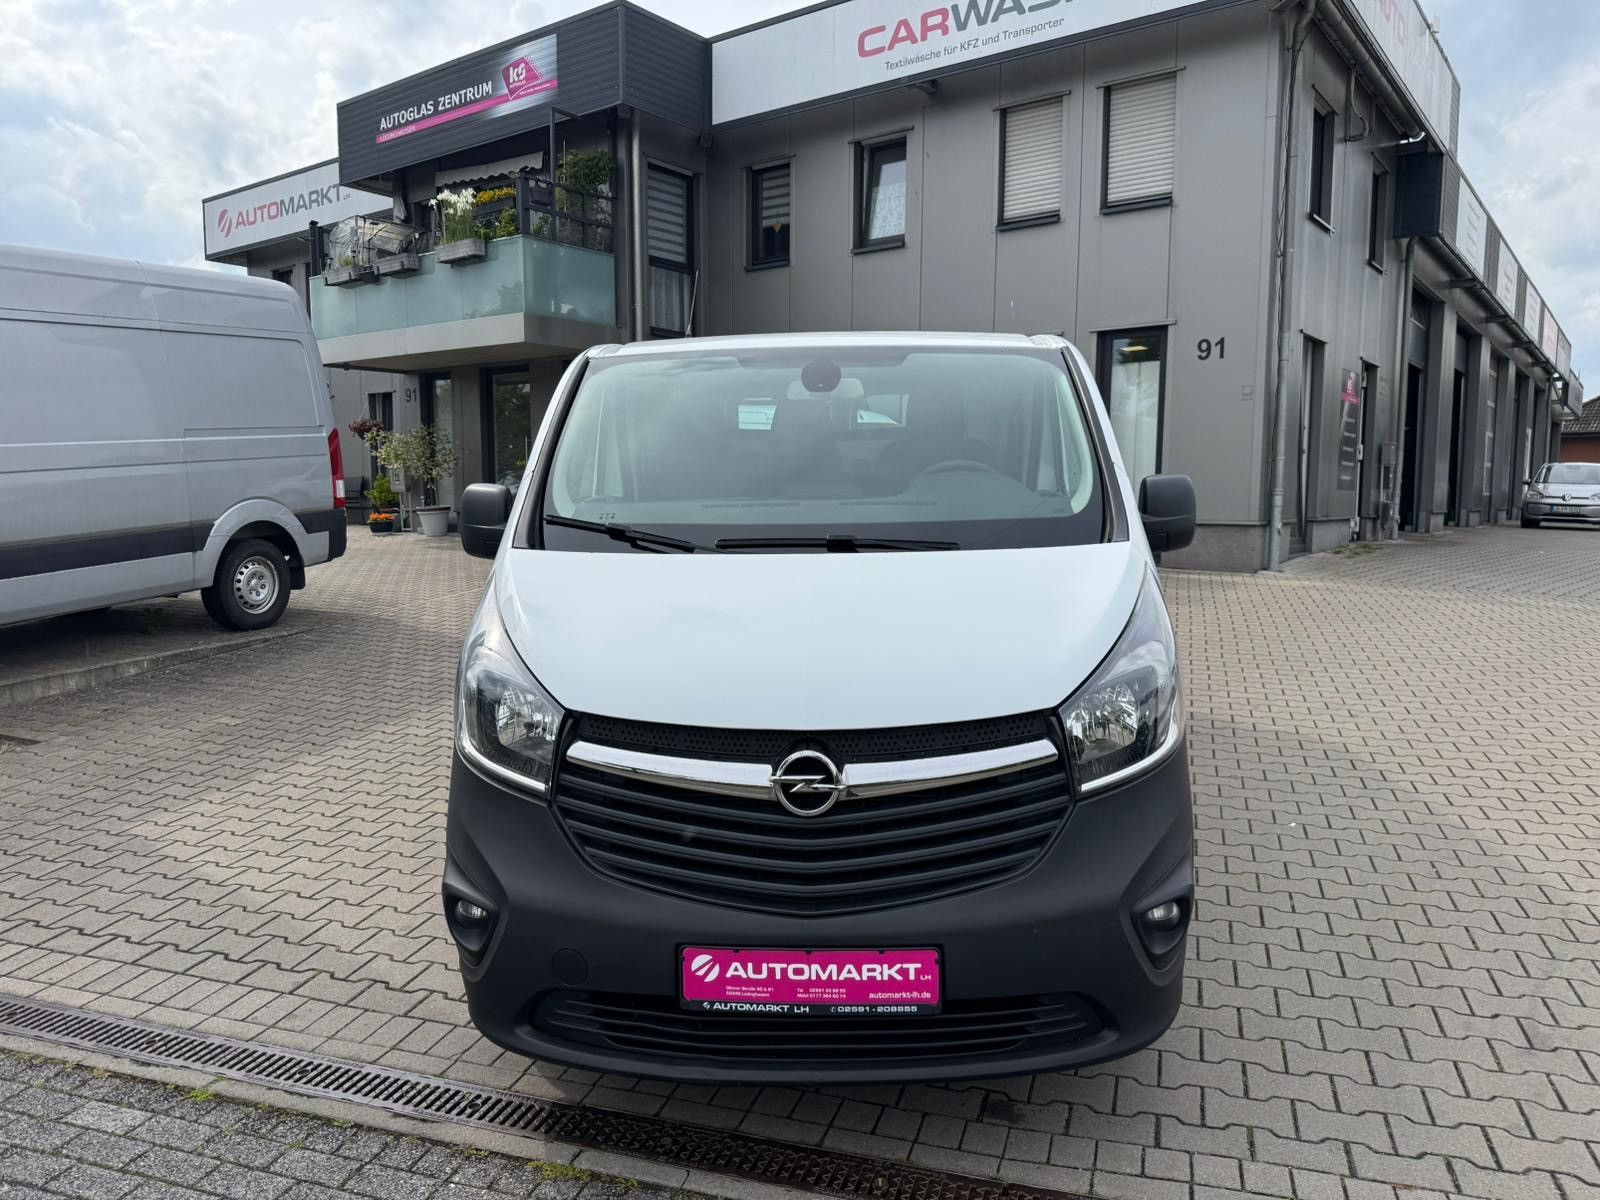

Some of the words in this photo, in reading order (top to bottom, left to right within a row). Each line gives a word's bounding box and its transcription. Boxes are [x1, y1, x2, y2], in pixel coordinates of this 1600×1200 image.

[857, 0, 1073, 58] CARWA
[943, 46, 958, 57] für
[959, 37, 980, 51] KFZ
[981, 34, 999, 47] und
[1002, 18, 1065, 41] Transporter
[380, 100, 434, 130] AUTOGLAS
[438, 80, 493, 111] ZENTRUM
[235, 184, 341, 229] AUTOMARKT
[1197, 337, 1225, 360] 91
[405, 388, 417, 402] 91
[725, 962, 922, 981] AUTOMARKT
[869, 991, 932, 999] automarkt-lh.de
[713, 1001, 789, 1013] AUTOMARKT
[794, 1005, 809, 1013] LH
